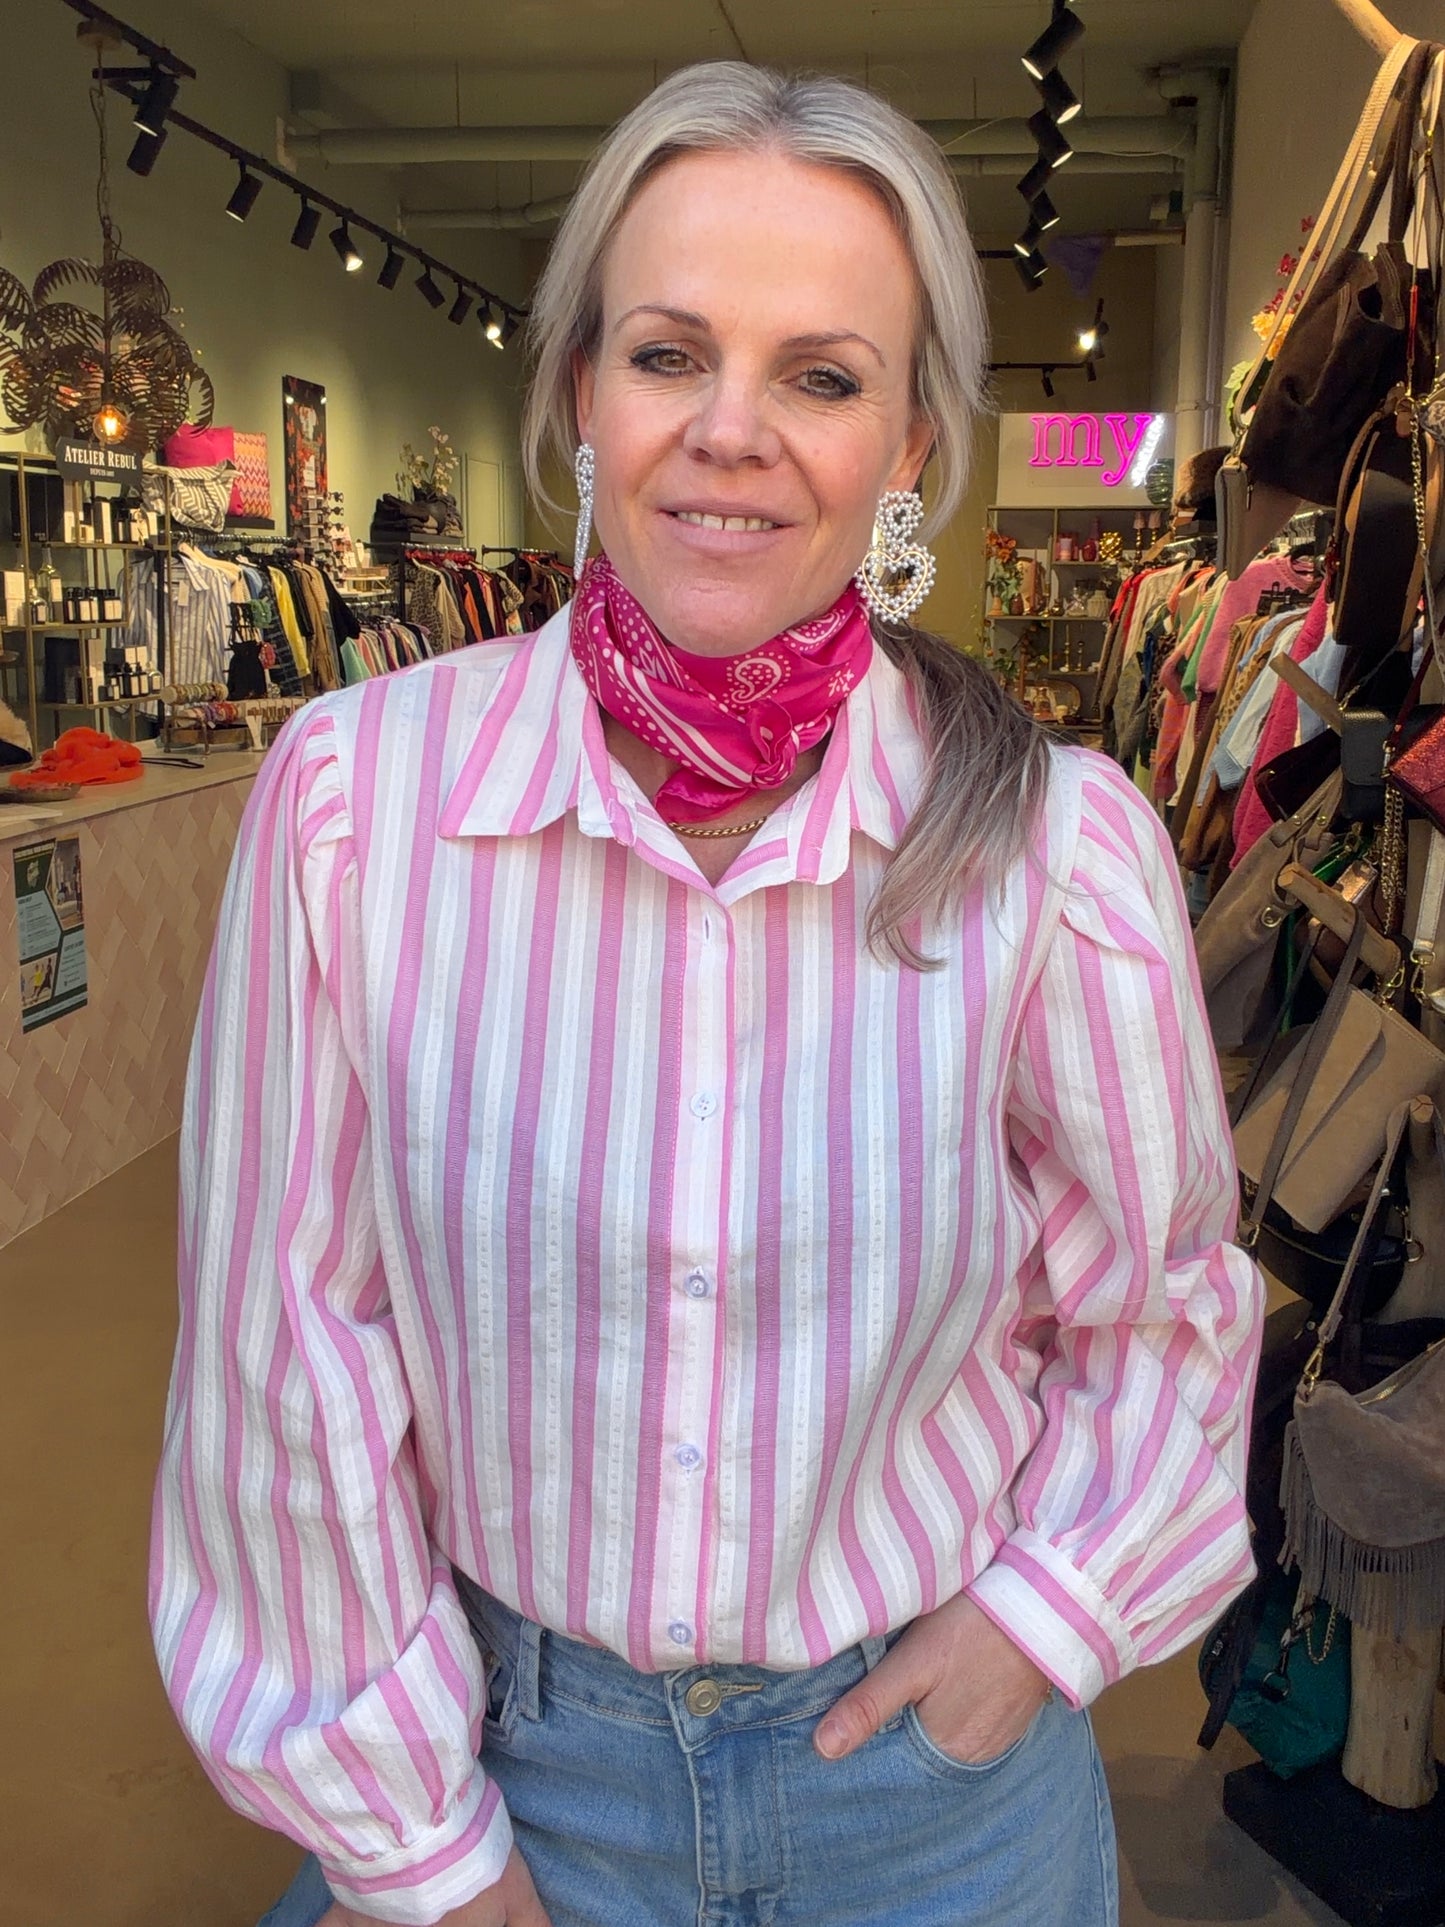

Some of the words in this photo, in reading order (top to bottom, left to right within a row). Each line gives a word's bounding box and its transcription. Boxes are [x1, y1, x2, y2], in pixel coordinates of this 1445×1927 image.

[64, 445, 105, 466] ATELIER
[107, 451, 137, 470] REBUL
[1029, 414, 1152, 485] my
